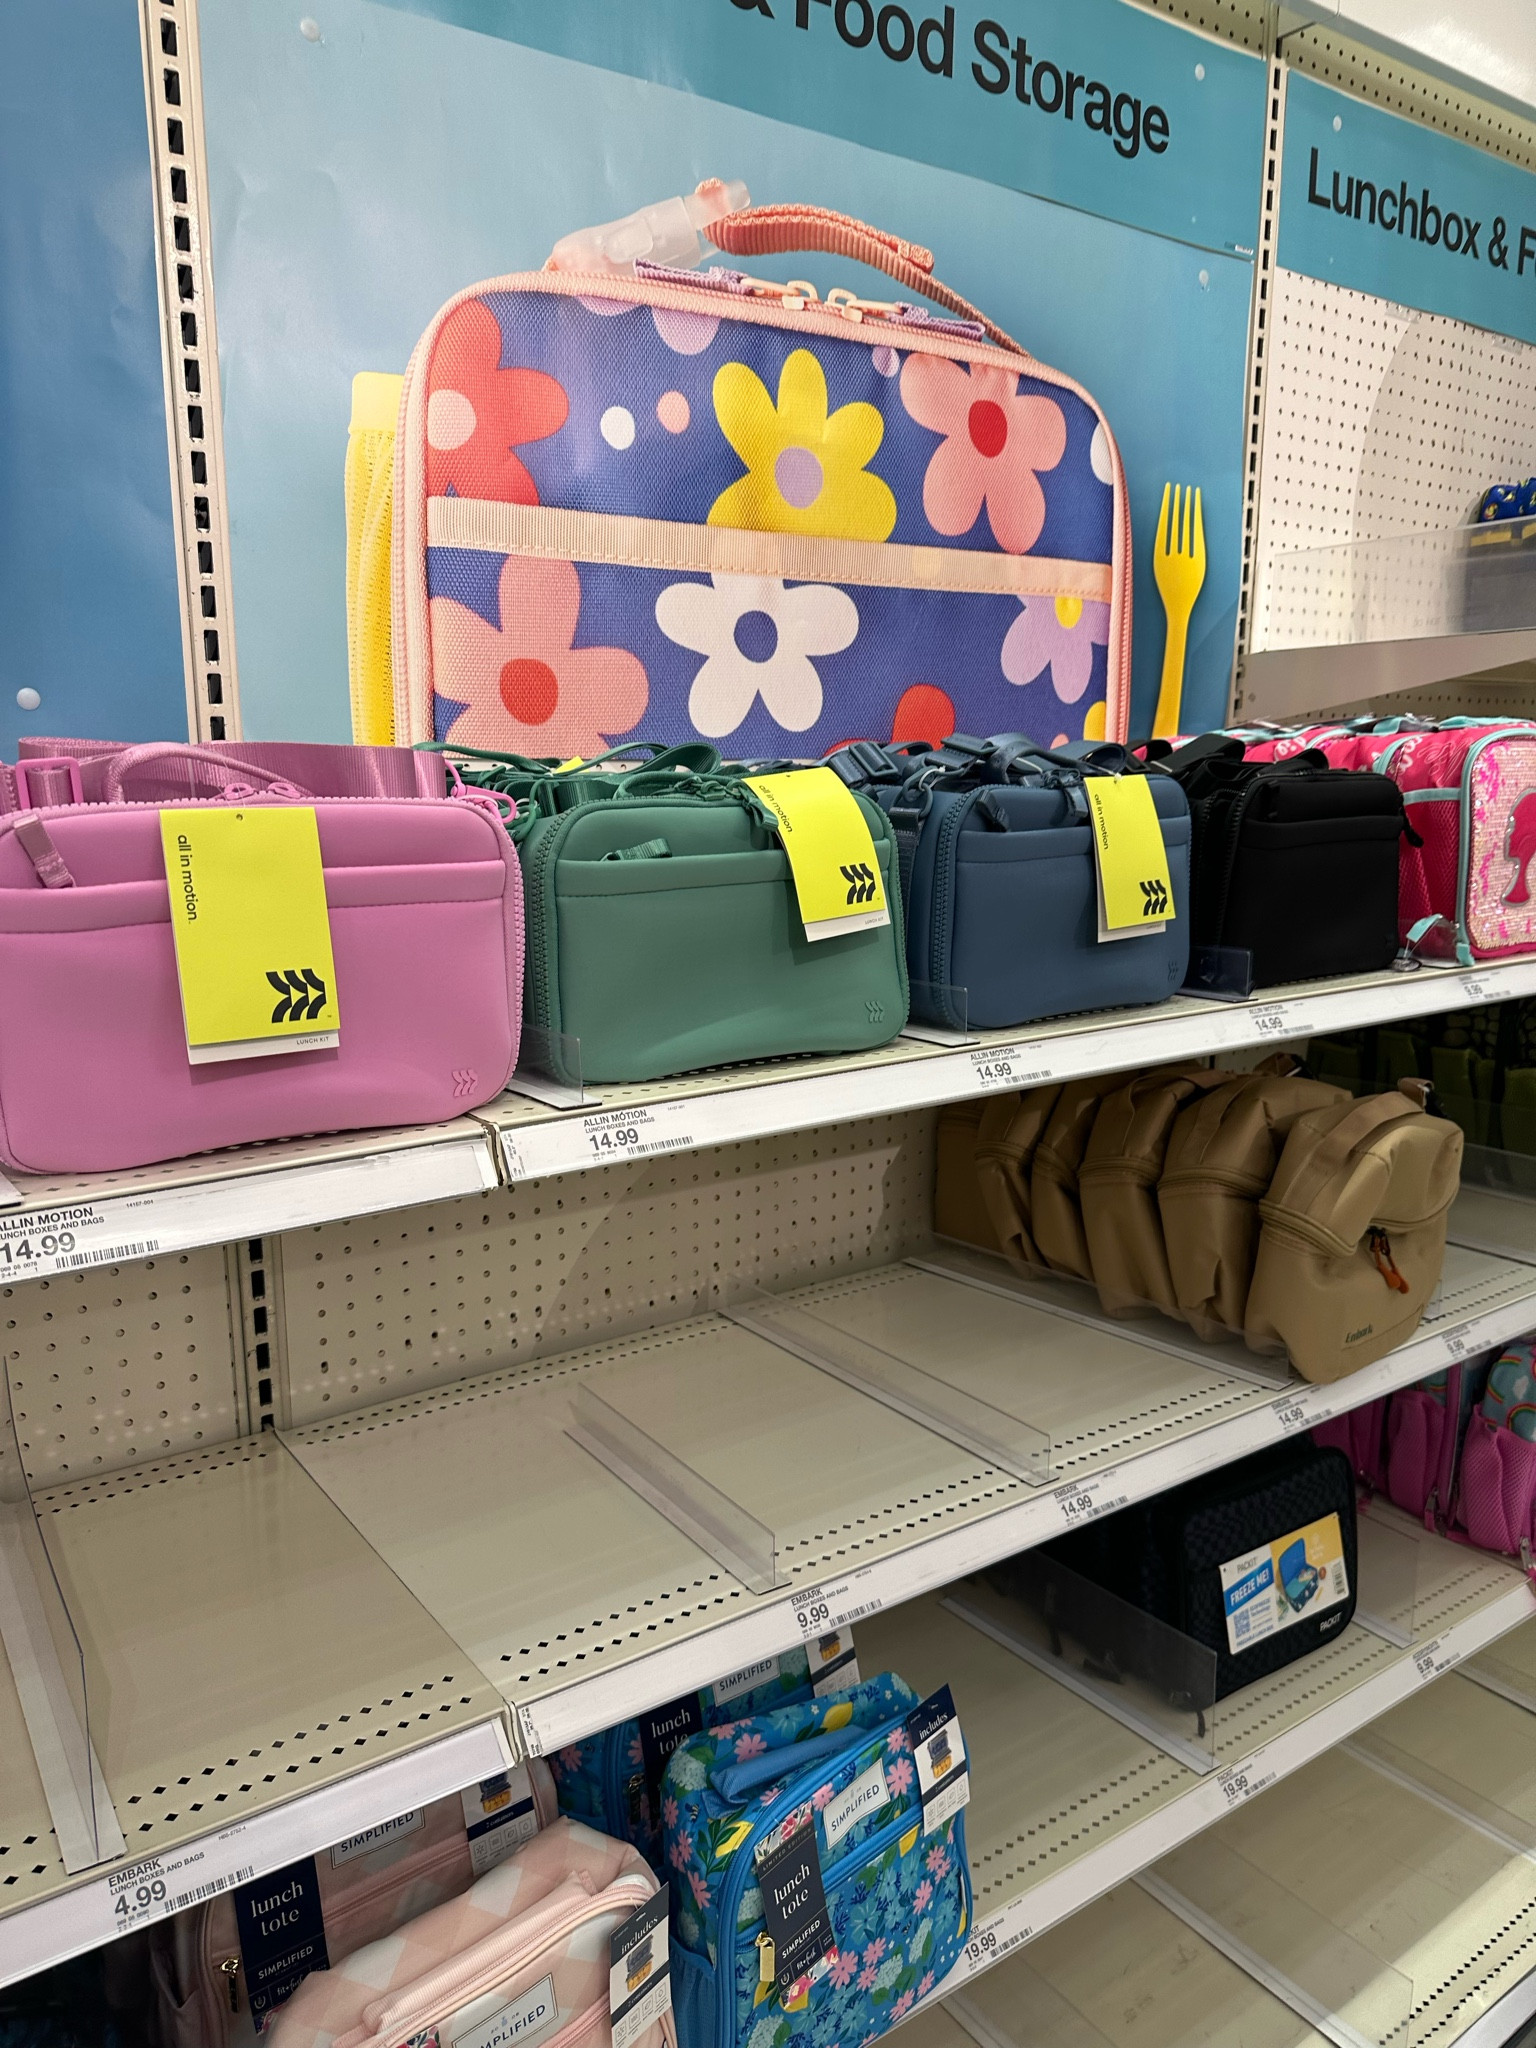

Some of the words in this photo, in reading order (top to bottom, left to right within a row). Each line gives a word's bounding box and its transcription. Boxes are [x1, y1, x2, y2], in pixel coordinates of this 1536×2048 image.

[971, 20, 1169, 158] Storage
[1308, 146, 1482, 259] Lunchbox
[1488, 216, 1509, 270] &
[759, 785, 771, 793] all
[766, 794, 774, 802] in
[772, 802, 793, 833] motion
[1094, 794, 1102, 805] all
[1097, 806, 1103, 816] in
[178, 834, 191, 852] all
[1099, 816, 1109, 850] motion
[180, 854, 193, 867] in
[182, 871, 199, 921] motion
[1255, 1017, 1283, 1031] 14.99
[296, 1037, 318, 1046] LUNCH
[319, 1036, 330, 1044] KIT
[970, 1051, 988, 1061] ALLIN
[989, 1047, 1015, 1059] MOTION
[976, 1062, 1012, 1080] 14.99
[584, 1116, 610, 1128] ALLIN
[611, 1109, 648, 1123] MOTION
[585, 1126, 606, 1134] LUNCH
[606, 1122, 626, 1131] BOXES
[626, 1119, 639, 1127] AND
[640, 1116, 655, 1125] BAGS
[590, 1128, 639, 1151] 14.99
[0, 1230, 27, 1240] UNCH
[29, 1223, 59, 1236] BOXES
[61, 1220, 79, 1230] AND
[81, 1216, 105, 1227] BAGS
[38, 1207, 94, 1226] MOTION
[0, 1232, 76, 1264] 14.99
[1279, 1407, 1304, 1425] 14.99
[1061, 1495, 1092, 1517] 14.99
[1237, 1557, 1257, 1574] PACKIT
[791, 1588, 823, 1606] EMBARK
[794, 1602, 810, 1612] LUNCH
[810, 1596, 825, 1606] BOXES
[836, 1586, 848, 1594] BAGS
[1230, 1579, 1256, 1607] FREEZE
[1256, 1568, 1270, 1587] ME!
[797, 1603, 829, 1628] 9.99
[1320, 1612, 1342, 1632] PACKIT
[719, 1659, 772, 1692] SIMPLIFIED
[652, 1709, 691, 1738] lunch
[919, 1712, 948, 1740] includes
[1223, 1775, 1248, 1798] 19.99
[831, 1784, 880, 1832] SIMPLIFIED
[341, 1812, 414, 1852] SIMPLIFIED
[108, 1858, 162, 1887] EMBARK
[762, 1848, 786, 1871] LIMITED
[110, 1880, 138, 1896] LUNCH
[139, 1868, 165, 1884] BOXES
[166, 1861, 183, 1874] AND
[183, 1852, 205, 1866] BAGS
[774, 1864, 810, 1905] lunch
[114, 1880, 166, 1915] 4.99
[251, 1881, 304, 1918] lunch
[782, 1889, 809, 1920] tote
[261, 1909, 300, 1936] tote
[621, 1915, 658, 1954] includes
[782, 1920, 820, 1959] SIMPLIFIED
[964, 1932, 997, 1961] 19.99
[258, 1946, 313, 1980] SIMPLIFIED
